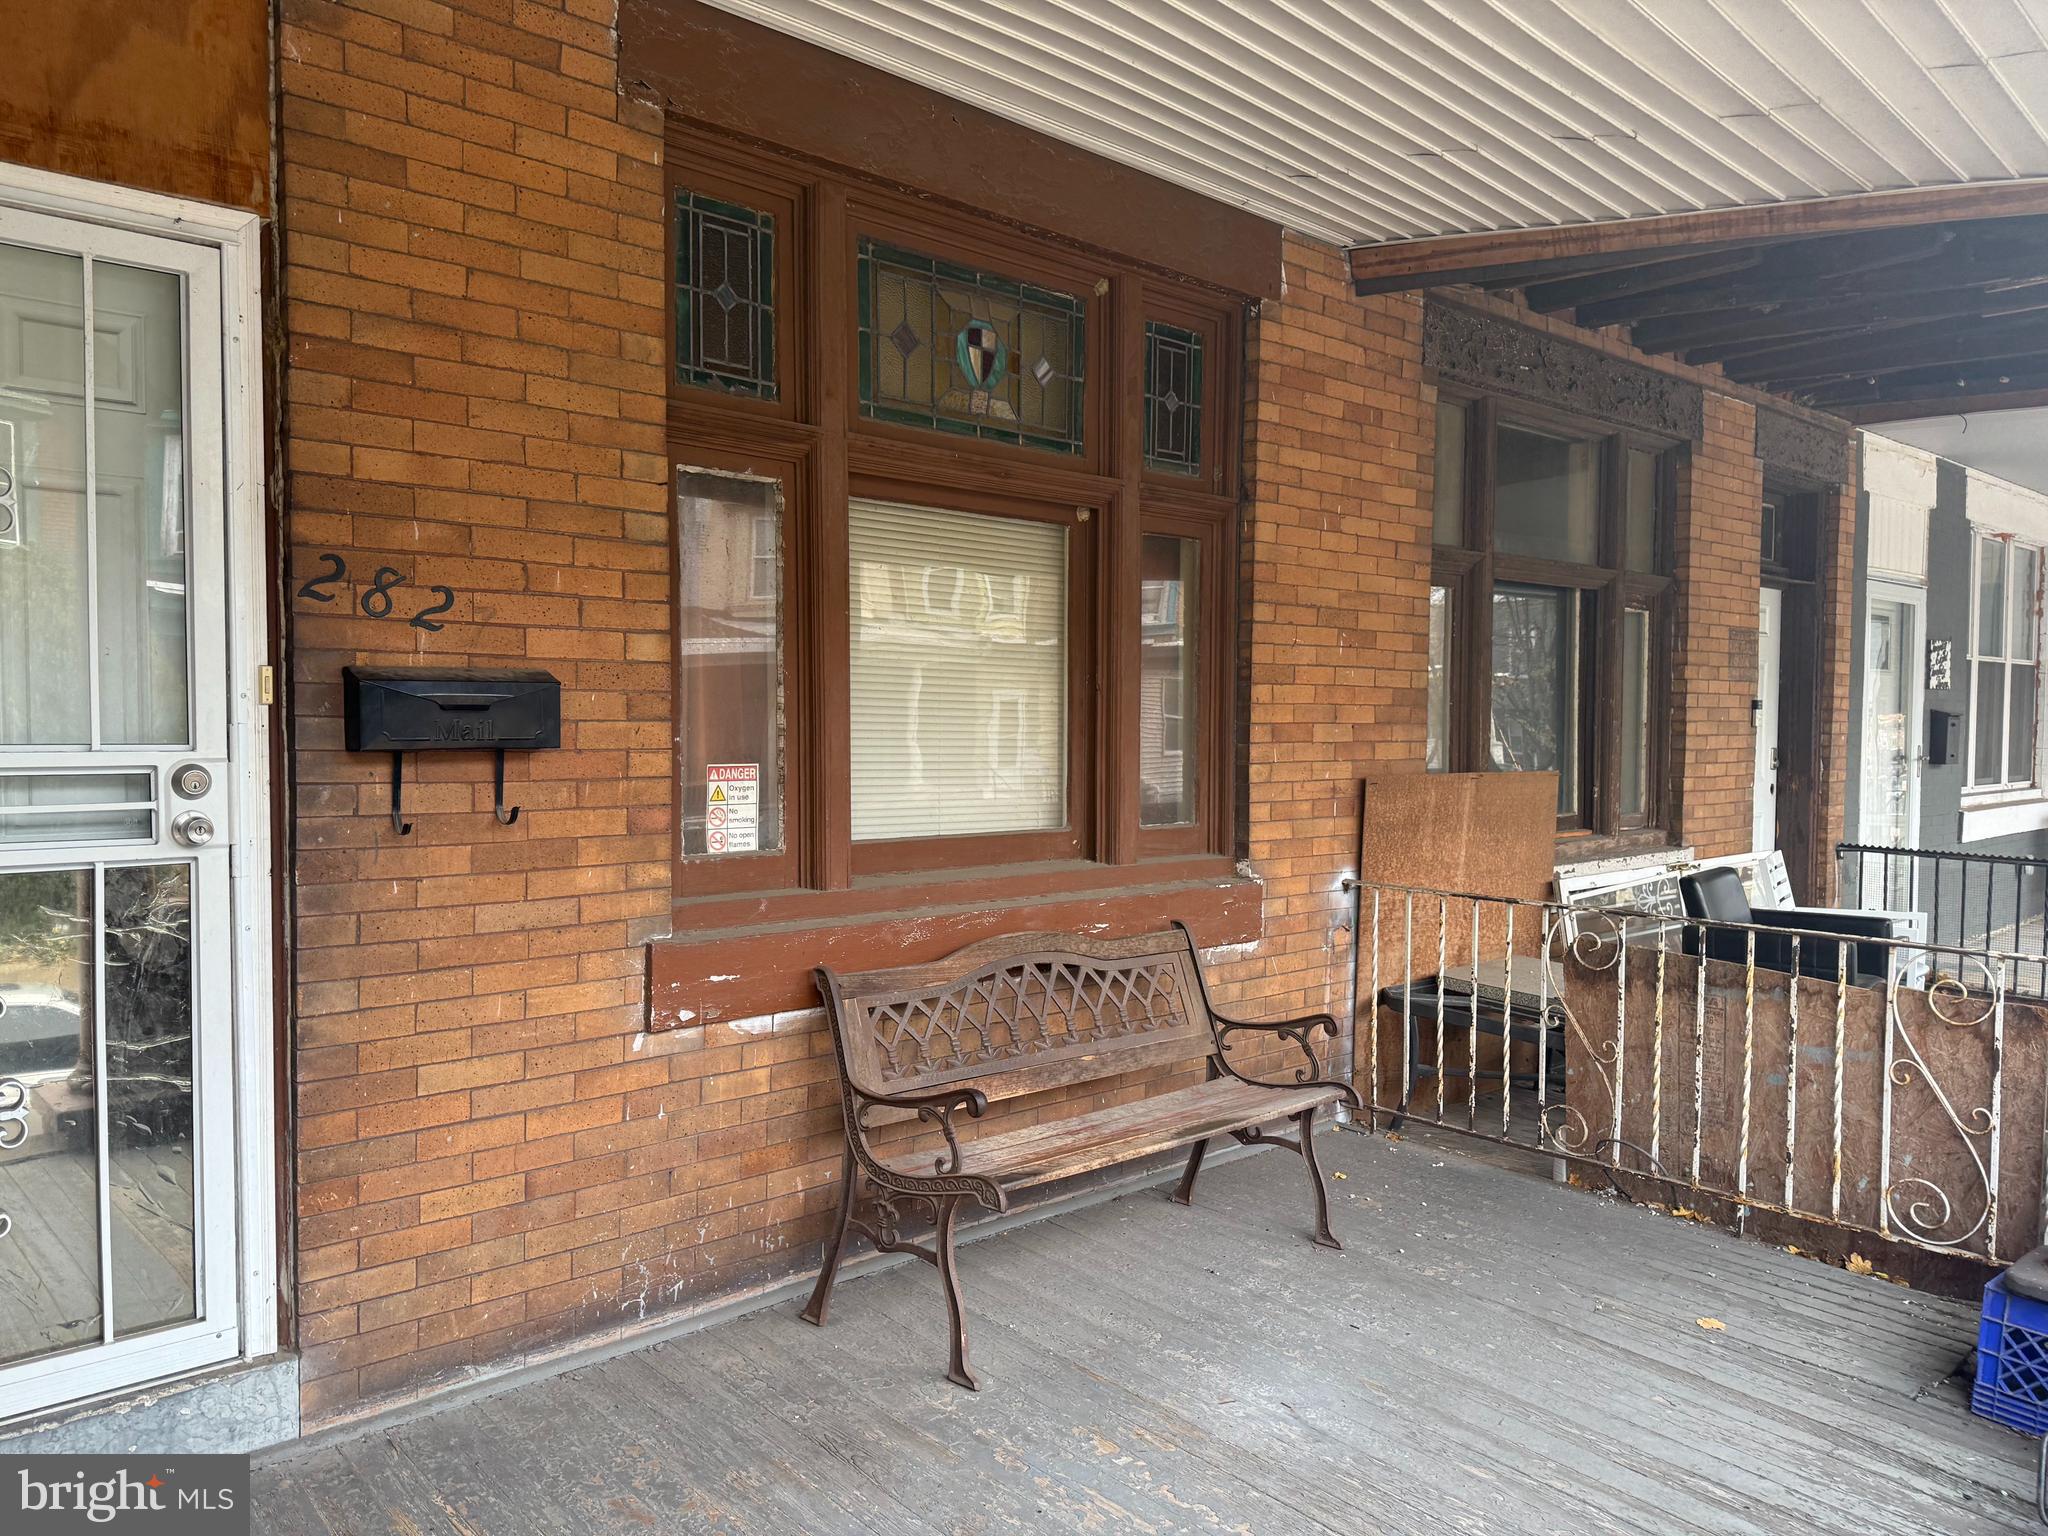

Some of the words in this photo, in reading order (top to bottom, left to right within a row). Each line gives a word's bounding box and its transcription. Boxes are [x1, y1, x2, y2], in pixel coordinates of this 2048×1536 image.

[297, 554, 455, 631] 282
[432, 719, 496, 742] Mail
[719, 767, 756, 780] DANGER
[728, 784, 755, 792] Oxygen
[728, 817, 755, 825] smoking
